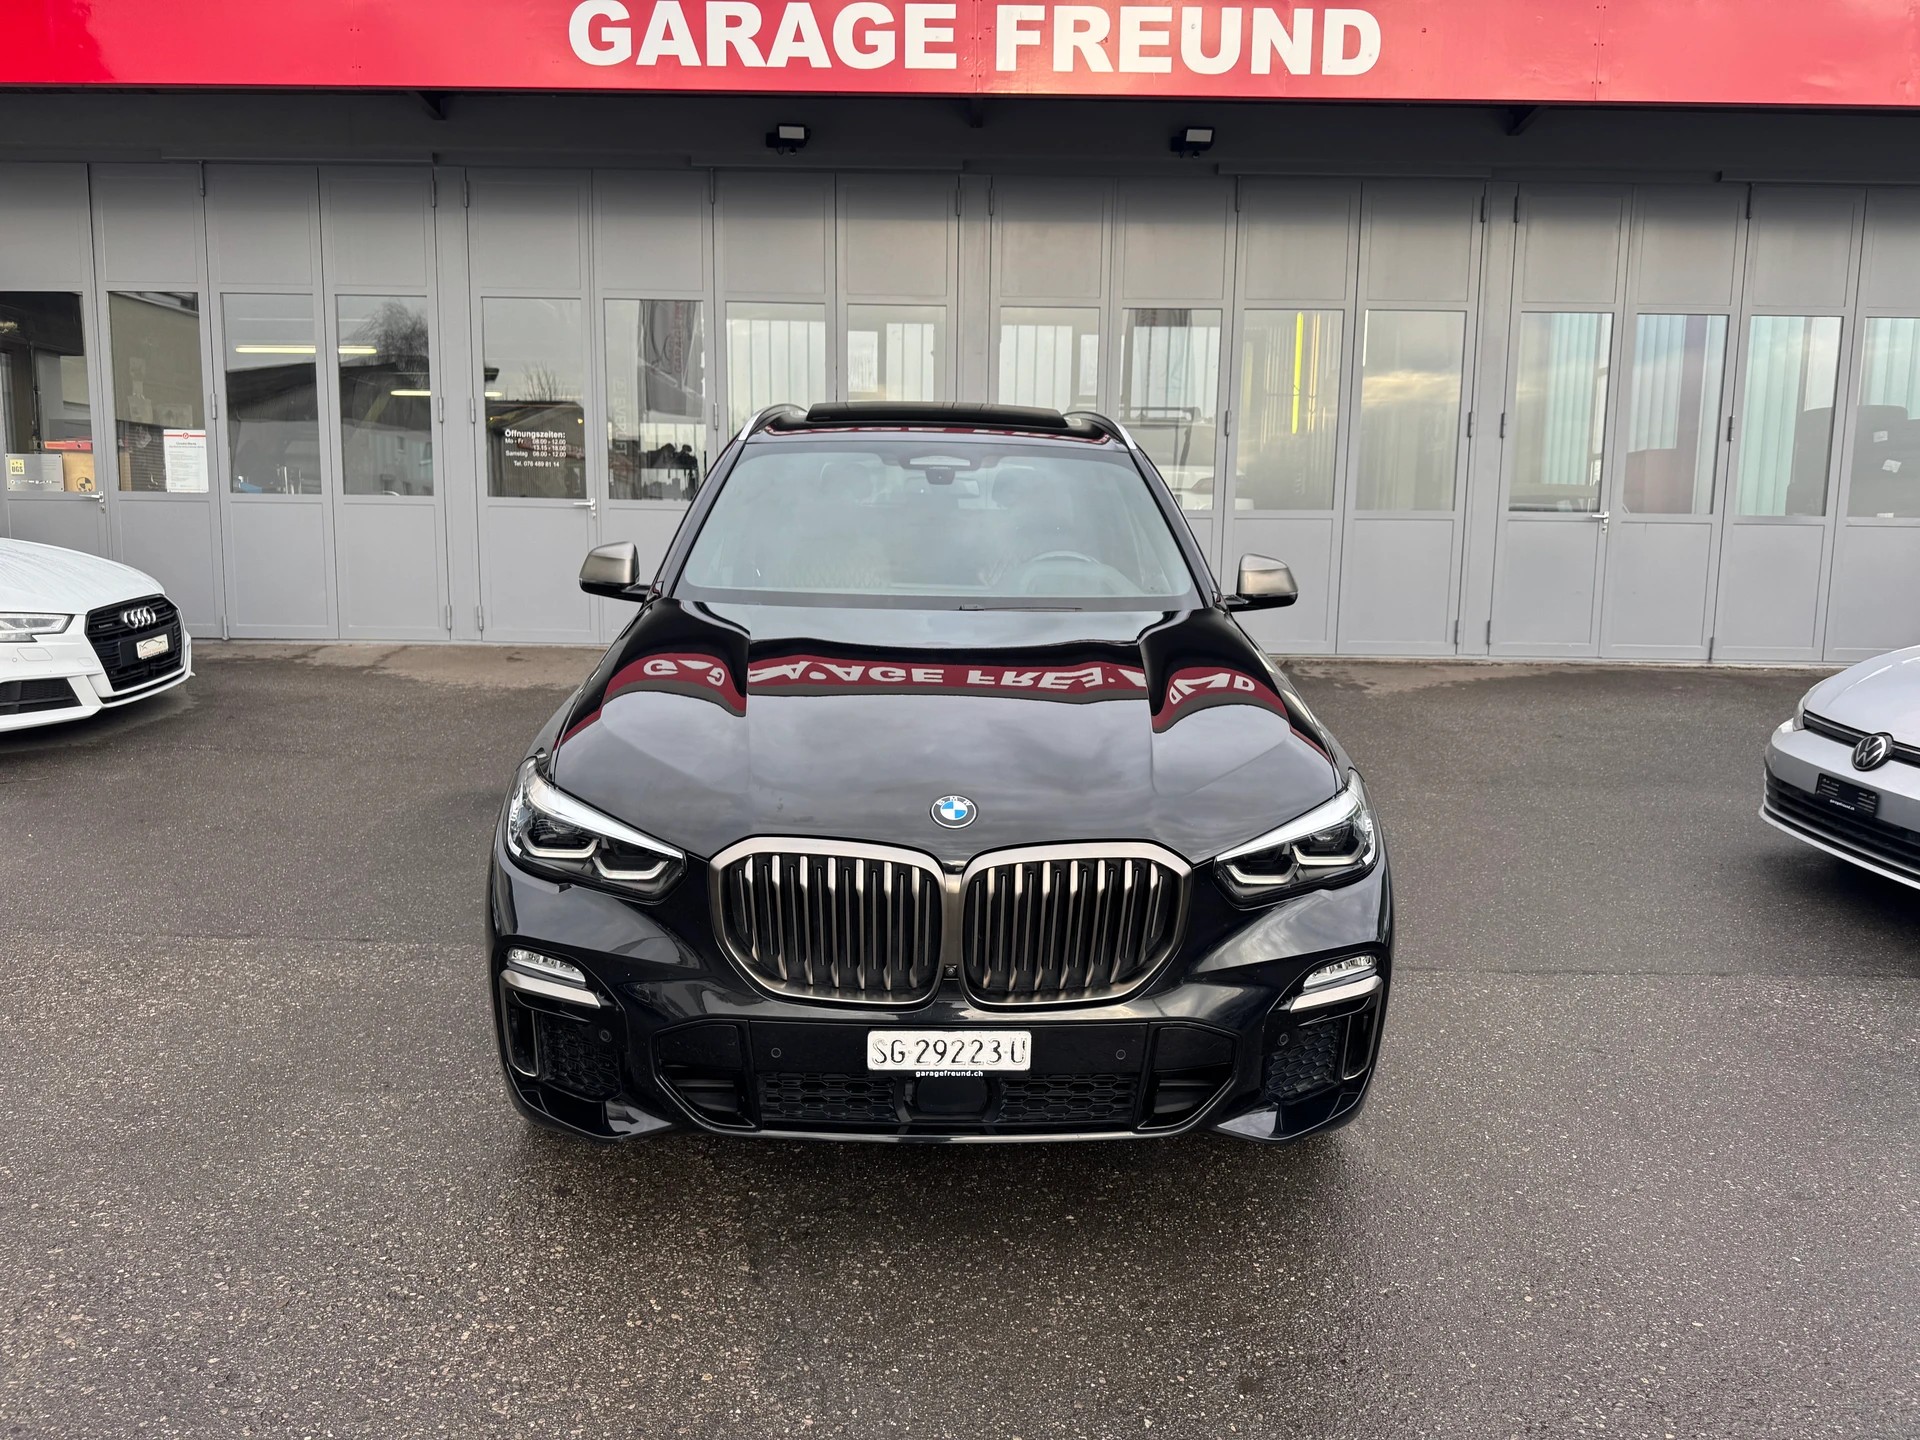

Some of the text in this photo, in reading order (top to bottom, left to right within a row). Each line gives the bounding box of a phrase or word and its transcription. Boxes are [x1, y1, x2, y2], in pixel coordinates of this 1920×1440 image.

[568, 0, 1382, 76] GARAGE FREUND
[915, 1070, 984, 1078] garagefreund.ch
